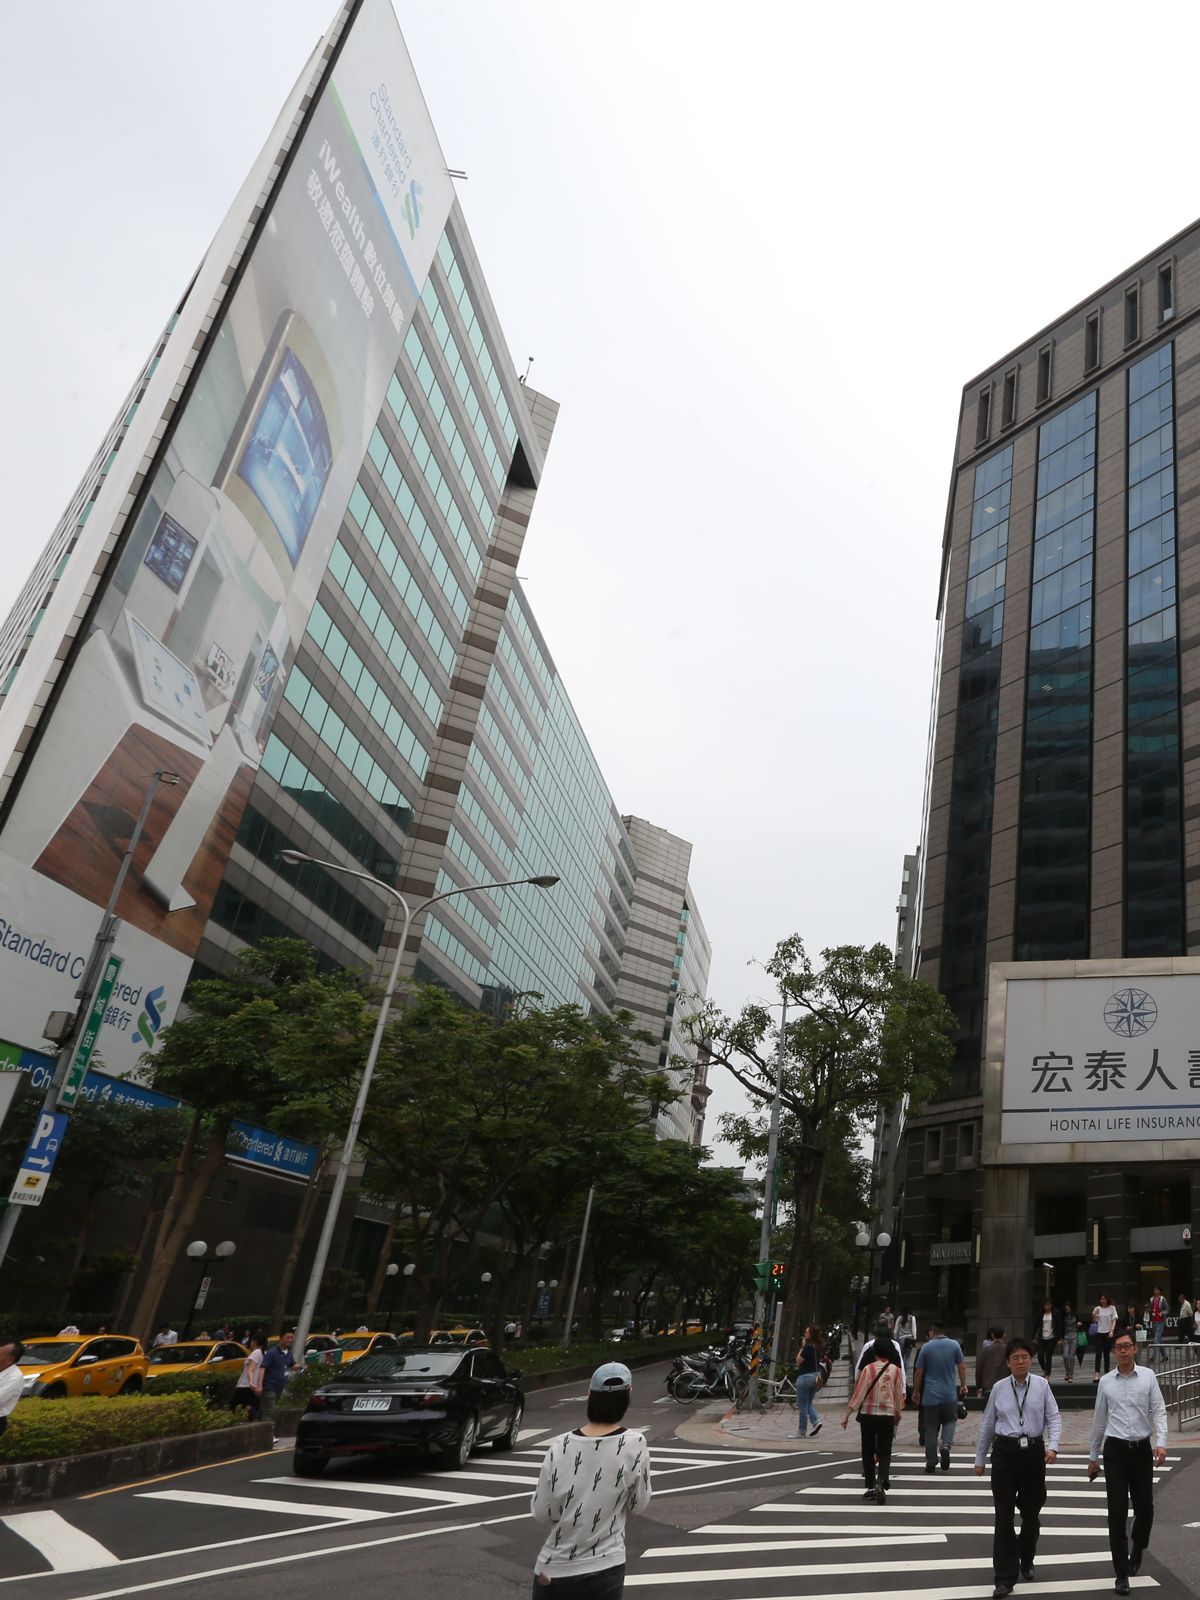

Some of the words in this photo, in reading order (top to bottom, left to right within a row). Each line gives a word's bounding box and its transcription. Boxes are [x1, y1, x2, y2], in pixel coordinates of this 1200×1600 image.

[369, 91, 407, 185] Chartered
[378, 82, 414, 169] Standard
[31, 1114, 55, 1150] P
[1049, 1118, 1101, 1132] HONTAI
[1106, 1117, 1131, 1130] LIFE
[772, 1263, 785, 1275] 21
